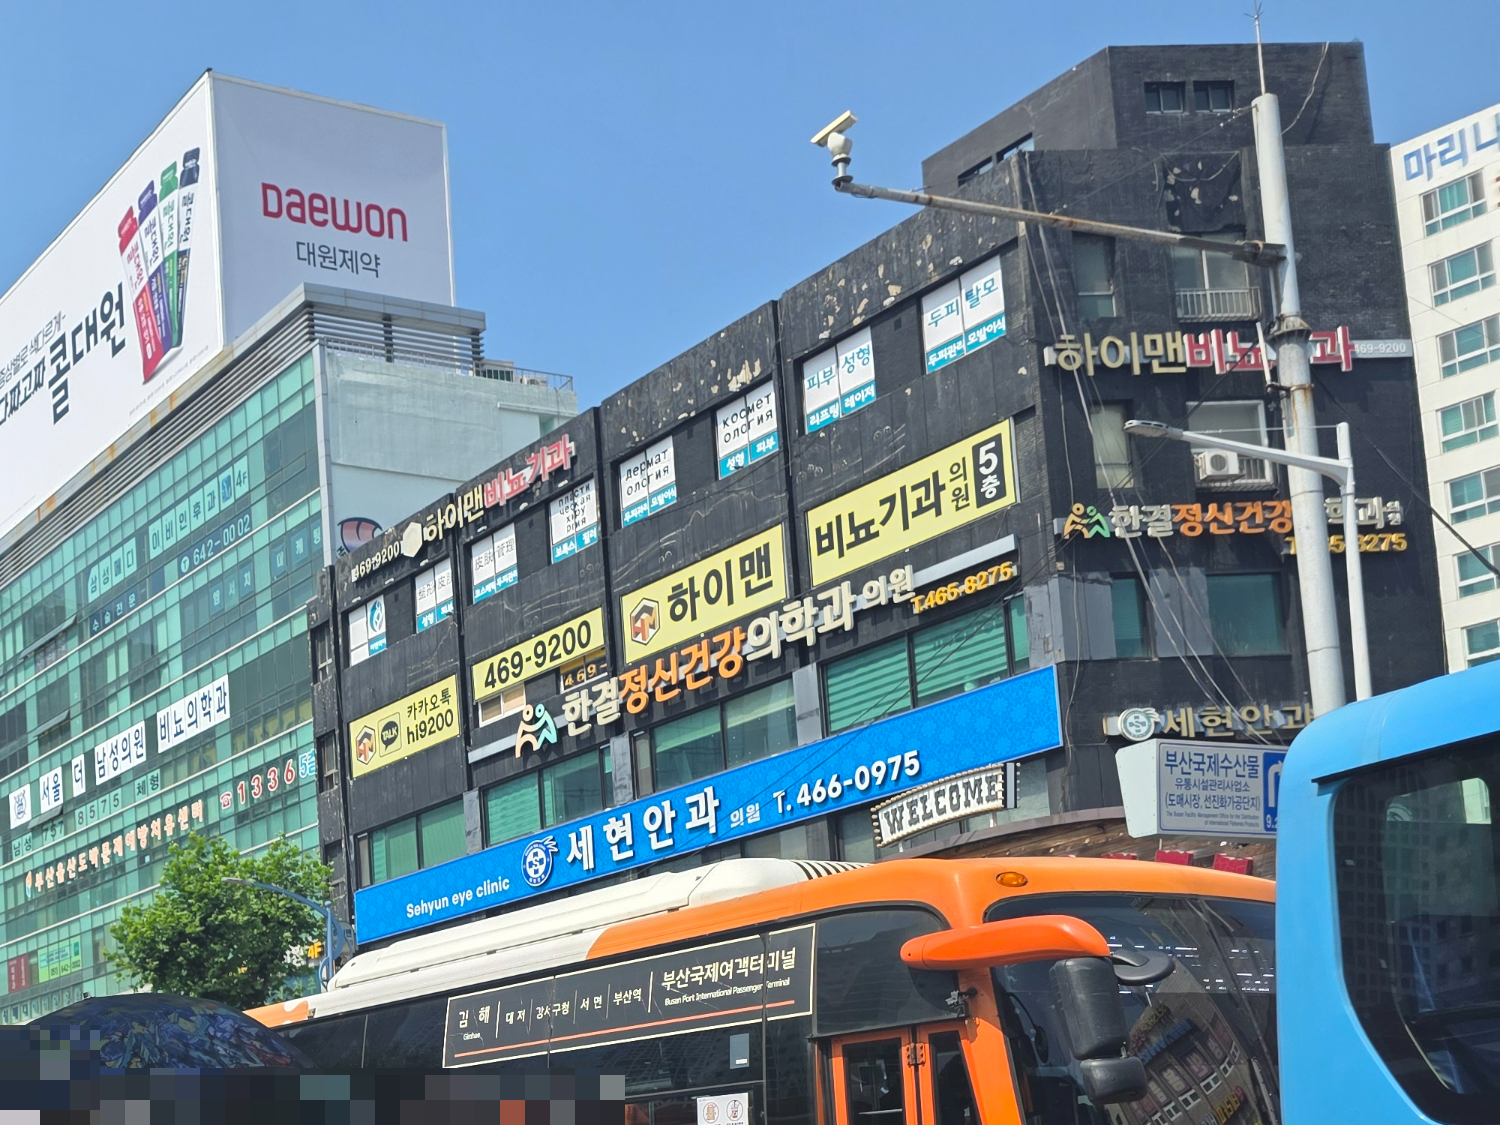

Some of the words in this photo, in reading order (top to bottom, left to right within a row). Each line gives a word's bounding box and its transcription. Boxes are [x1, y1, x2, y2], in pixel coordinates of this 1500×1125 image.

[296, 240, 382, 279] 대원제약
[928, 299, 960, 327] 두피
[965, 277, 999, 309] 탈모
[48, 283, 126, 425] 콜대원
[807, 366, 836, 390] 피부
[841, 344, 871, 373] 성형
[1056, 325, 1356, 376] 하이맨비뇨과
[809, 402, 839, 426] 리프팅
[844, 386, 875, 408] 레이저
[235, 469, 247, 488] 4F
[949, 457, 970, 511] 의원
[979, 441, 1000, 499] 5층
[152, 491, 216, 552] 이비인후과
[815, 470, 946, 559] 비뇨기과
[667, 542, 774, 622] 하이맨
[862, 564, 915, 609] 의원
[485, 620, 592, 689] 469-9200
[406, 708, 454, 745] hi9200
[407, 687, 452, 721] 카카오톡
[1163, 702, 1314, 738] 세현안과
[41, 772, 62, 804] 서울
[73, 763, 85, 789] 더
[96, 727, 145, 780] 남성의원
[159, 685, 228, 744] 비뇨의학과
[1164, 750, 1260, 779] 부산국제수산물
[238, 758, 296, 806] 1336
[1165, 791, 1203, 809] (도매시장,
[1204, 795, 1261, 812] 선진화가공단지)
[1174, 777, 1251, 792] 유통시설관리사업소
[12, 835, 33, 858] 남성
[77, 792, 121, 826] 8575
[136, 772, 161, 797] 체형
[566, 785, 720, 871] 세현안과
[730, 802, 761, 829] 의원
[797, 749, 921, 807] 466-0975
[883, 774, 1000, 836] WELCOME
[406, 895, 449, 919] Sehyun
[451, 888, 473, 907] eye
[476, 875, 510, 898] clinic
[307, 941, 323, 959] 4F
[661, 946, 797, 991] 부산국제여객터미널
[536, 1000, 570, 1020] 강서구청
[613, 988, 643, 1006] 부산역
[664, 996, 682, 1007] Busan
[695, 986, 733, 1001] International
